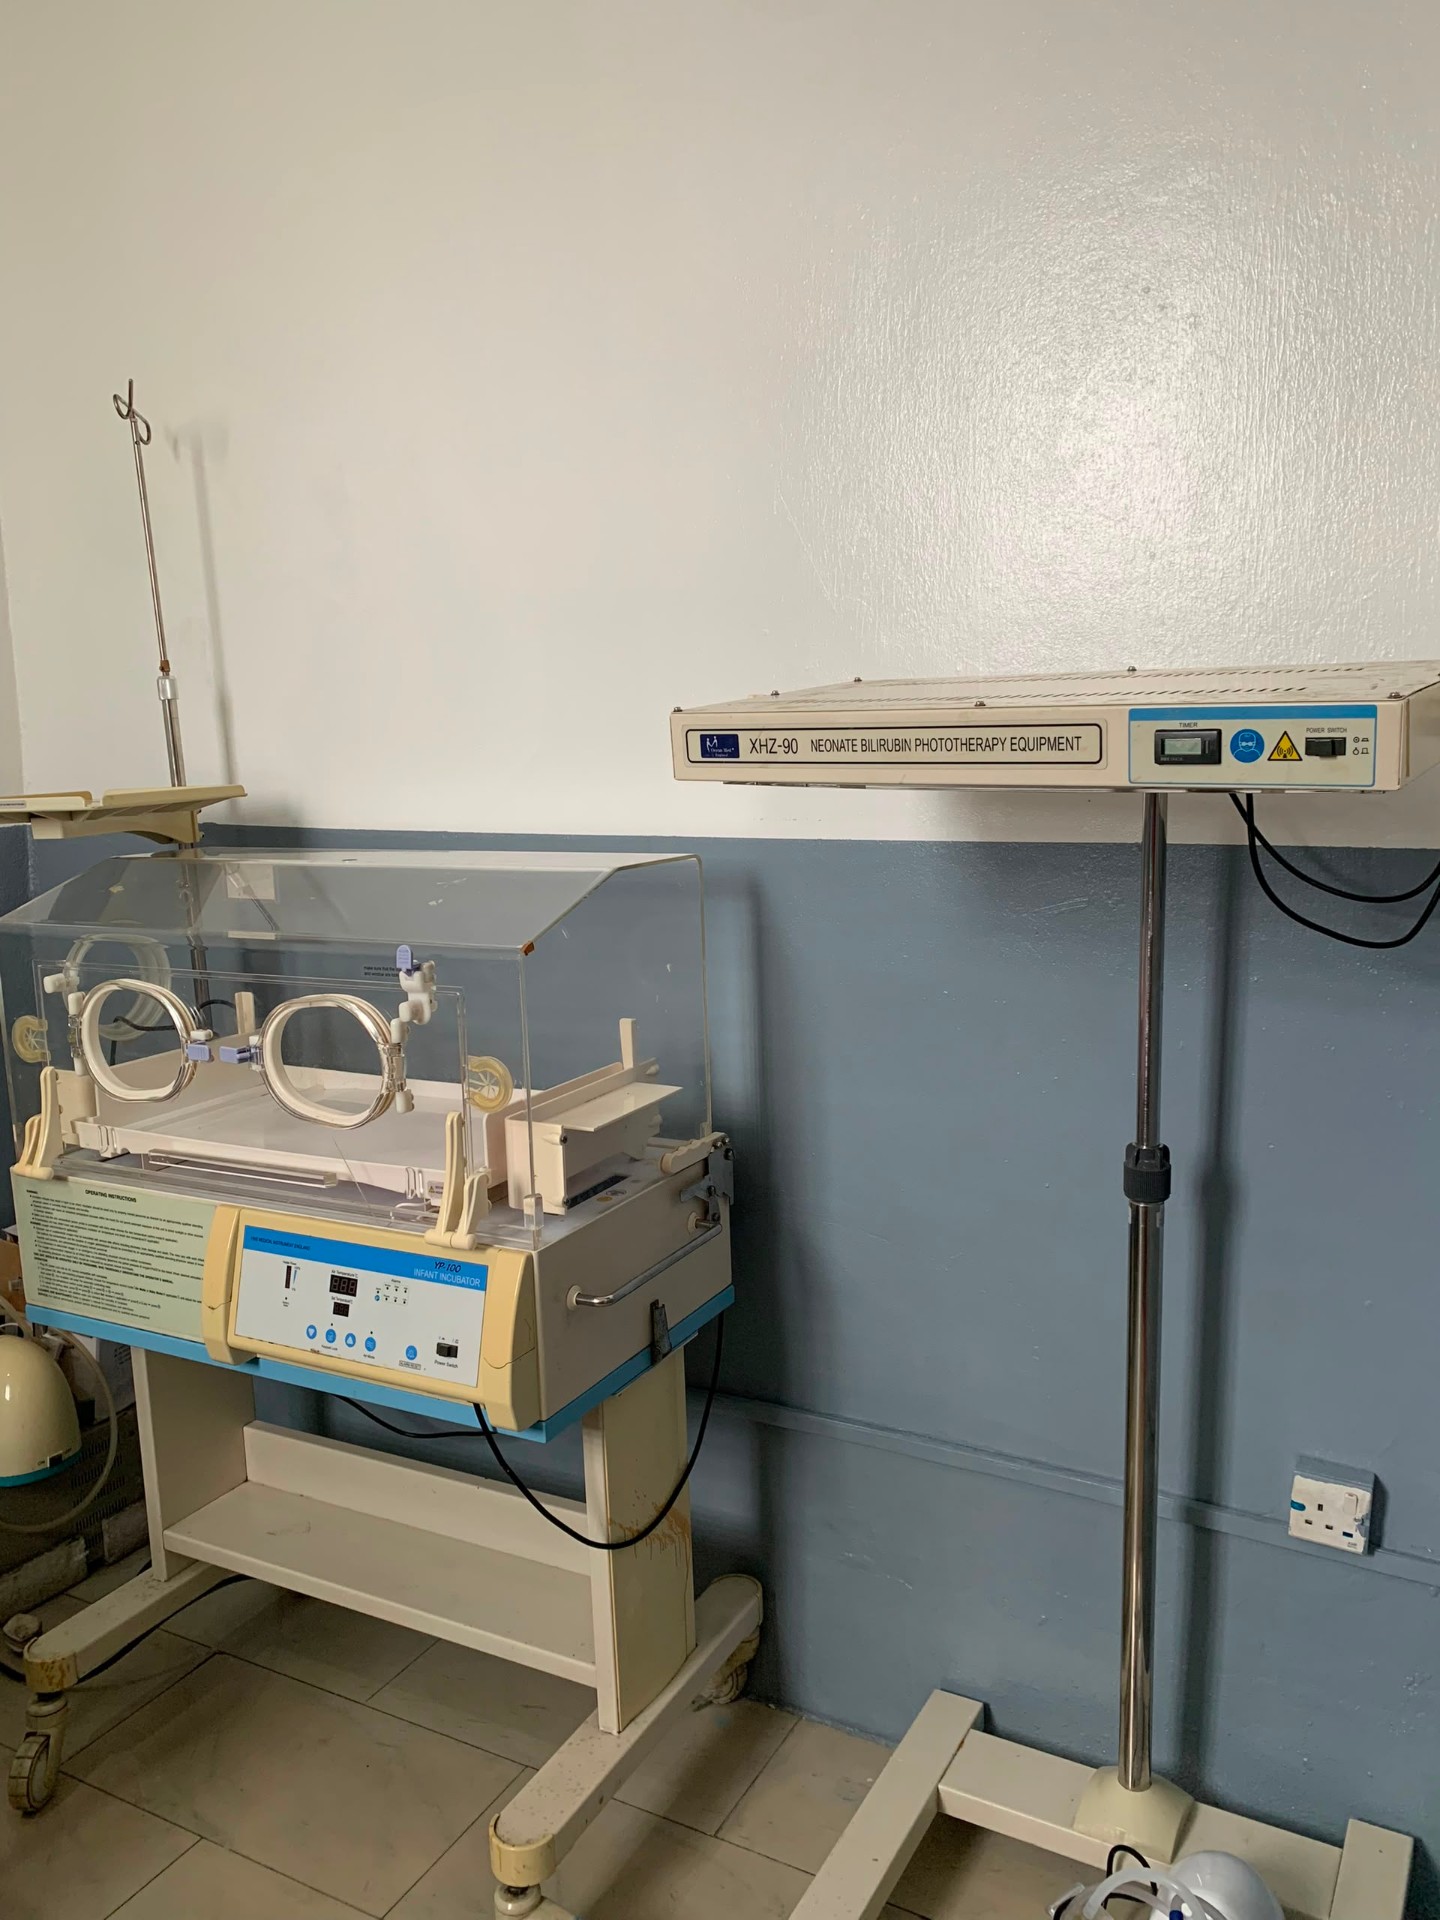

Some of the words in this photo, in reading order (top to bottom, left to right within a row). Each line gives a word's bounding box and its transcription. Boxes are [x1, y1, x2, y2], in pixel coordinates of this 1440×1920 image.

[749, 738, 798, 754] XHZ-90
[811, 738, 858, 752] NEONATE
[860, 738, 912, 752] BILIRUBIN
[914, 737, 1007, 752] PHOTOTHERAPY
[1010, 736, 1082, 752] EQUIPMENT
[85, 1189, 107, 1198] OPERATING
[108, 1193, 136, 1203] INSTRUCTIONS
[413, 1268, 438, 1279] INFANT
[440, 1273, 481, 1287] INCUBATOR
